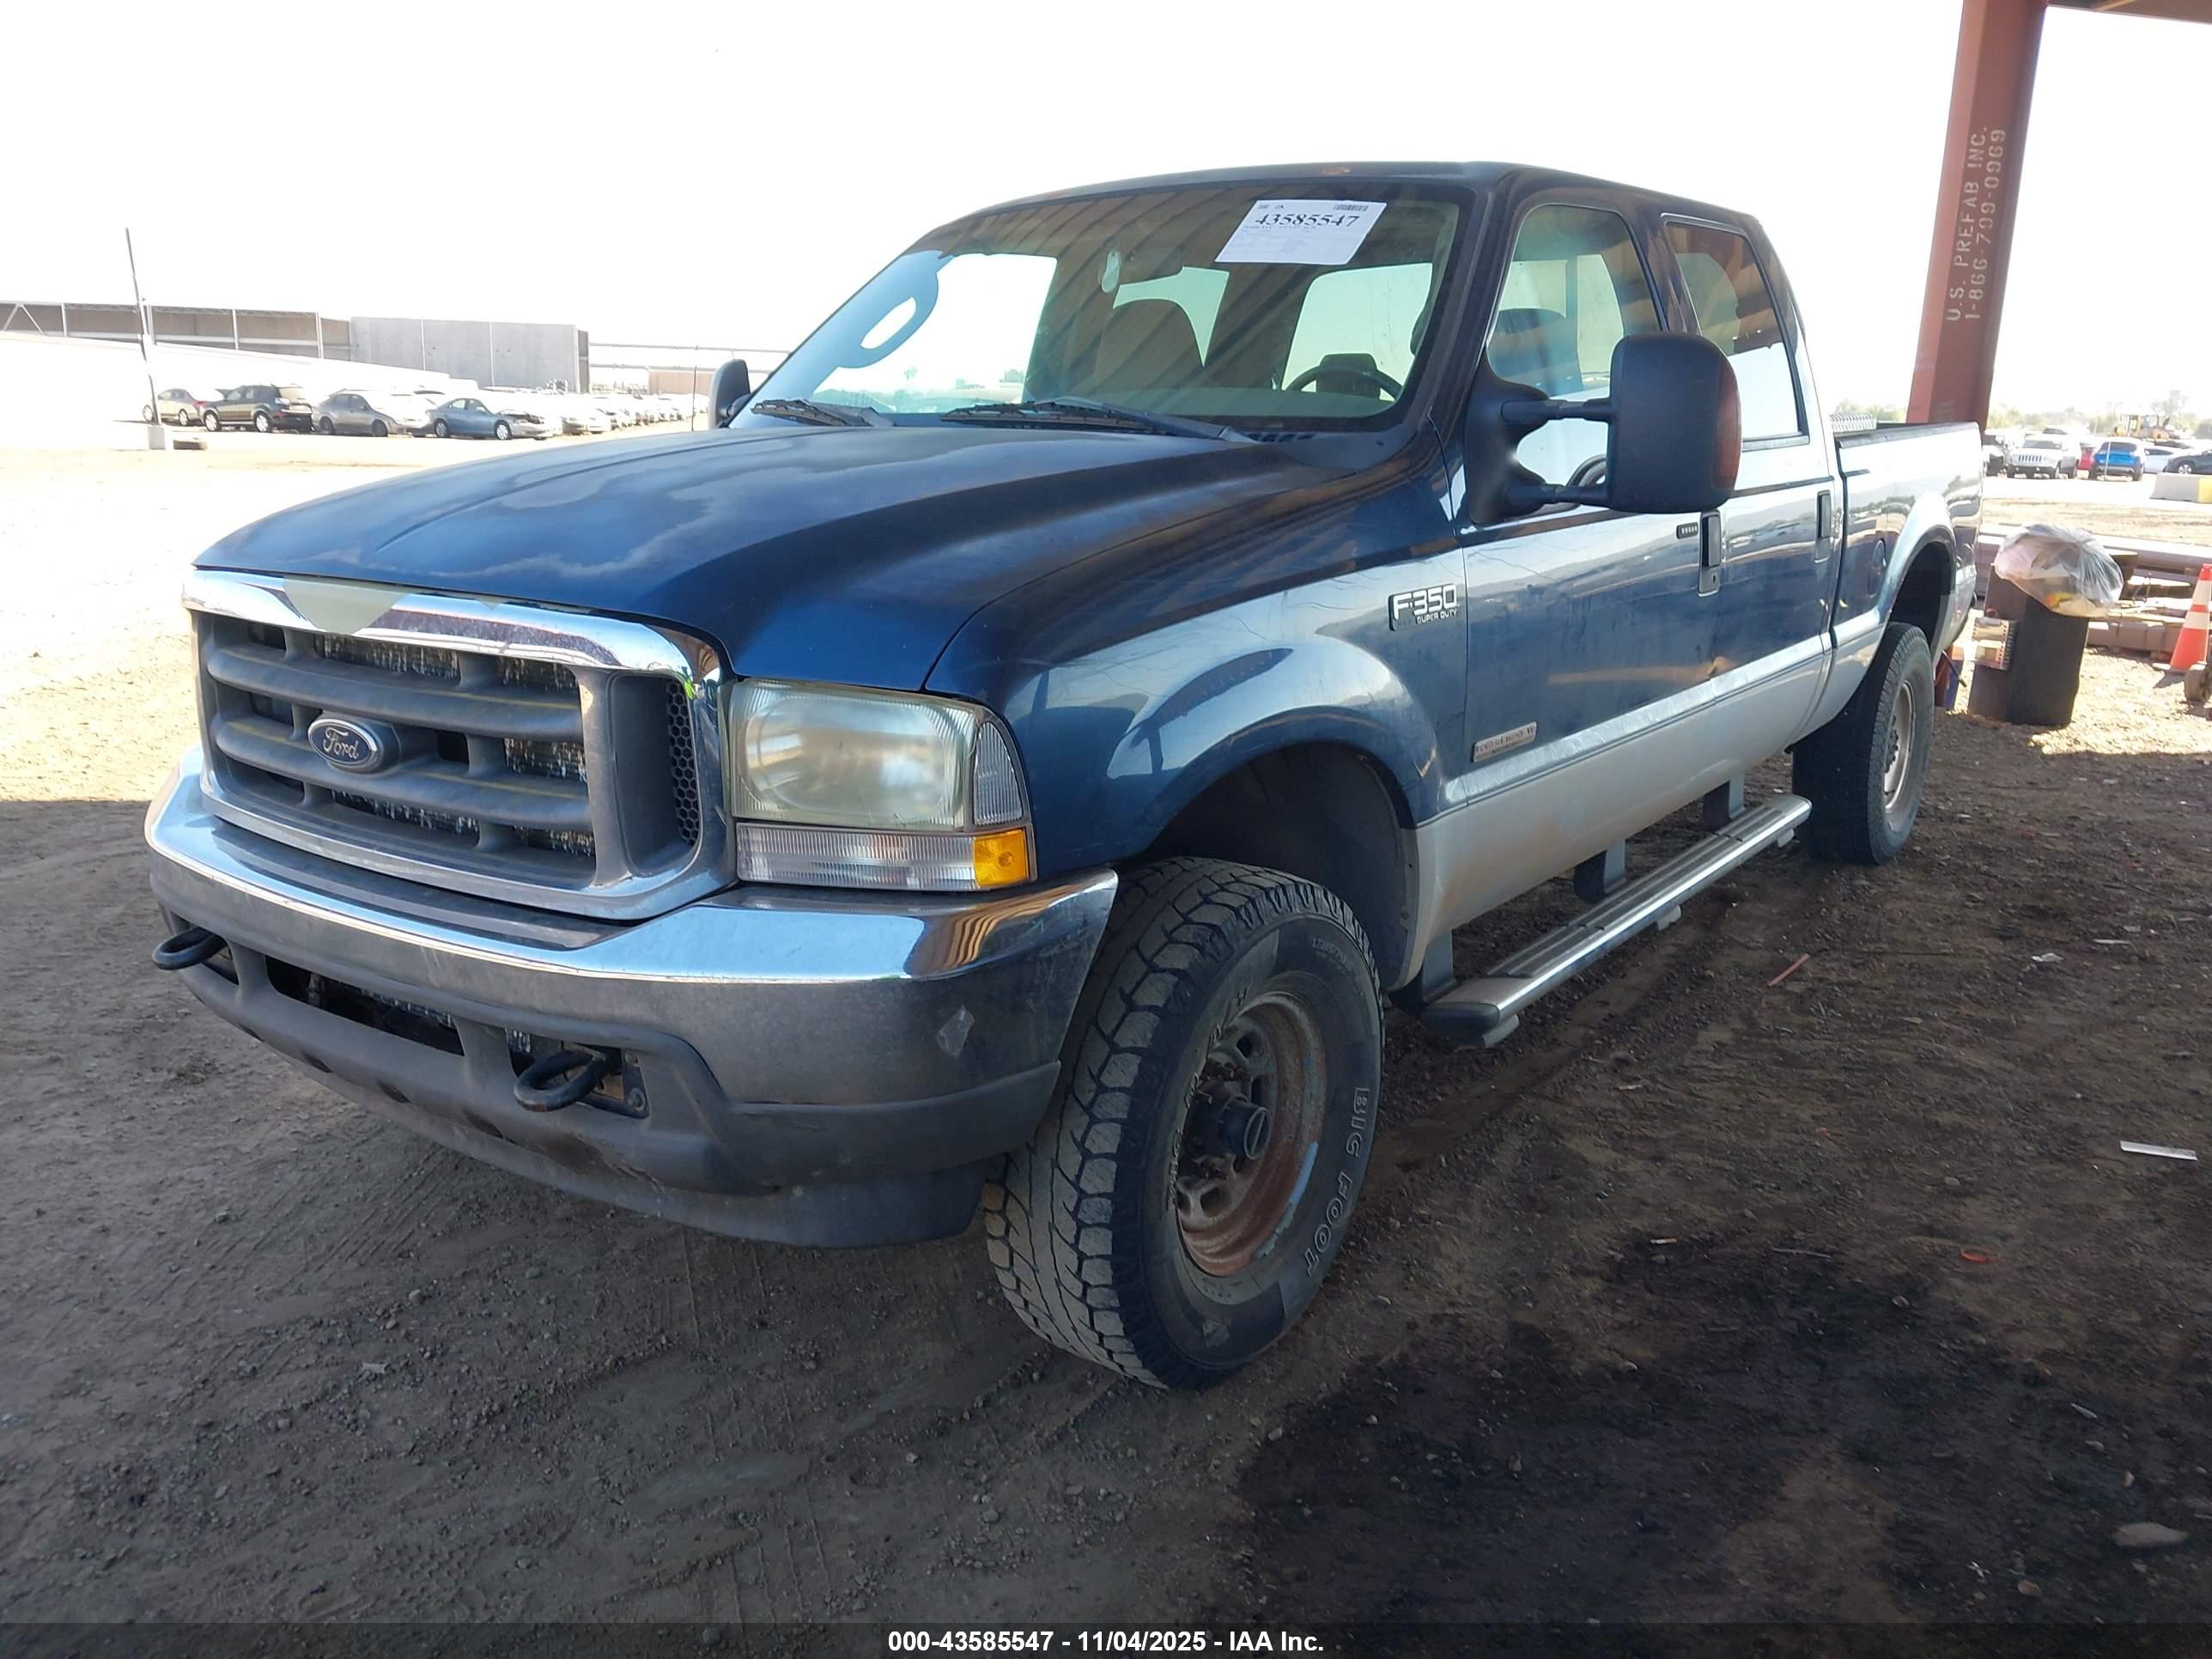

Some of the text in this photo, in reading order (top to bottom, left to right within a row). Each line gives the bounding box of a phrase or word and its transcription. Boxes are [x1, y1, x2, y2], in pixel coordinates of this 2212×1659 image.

[1255, 213, 1360, 228] 43585547
[1947, 126, 1988, 321] U.S. PREFAB INC.
[1417, 608, 1457, 625] SUPER DUTY
[323, 726, 359, 760] Ford
[1305, 1086, 1370, 1278] BIG FOOT
